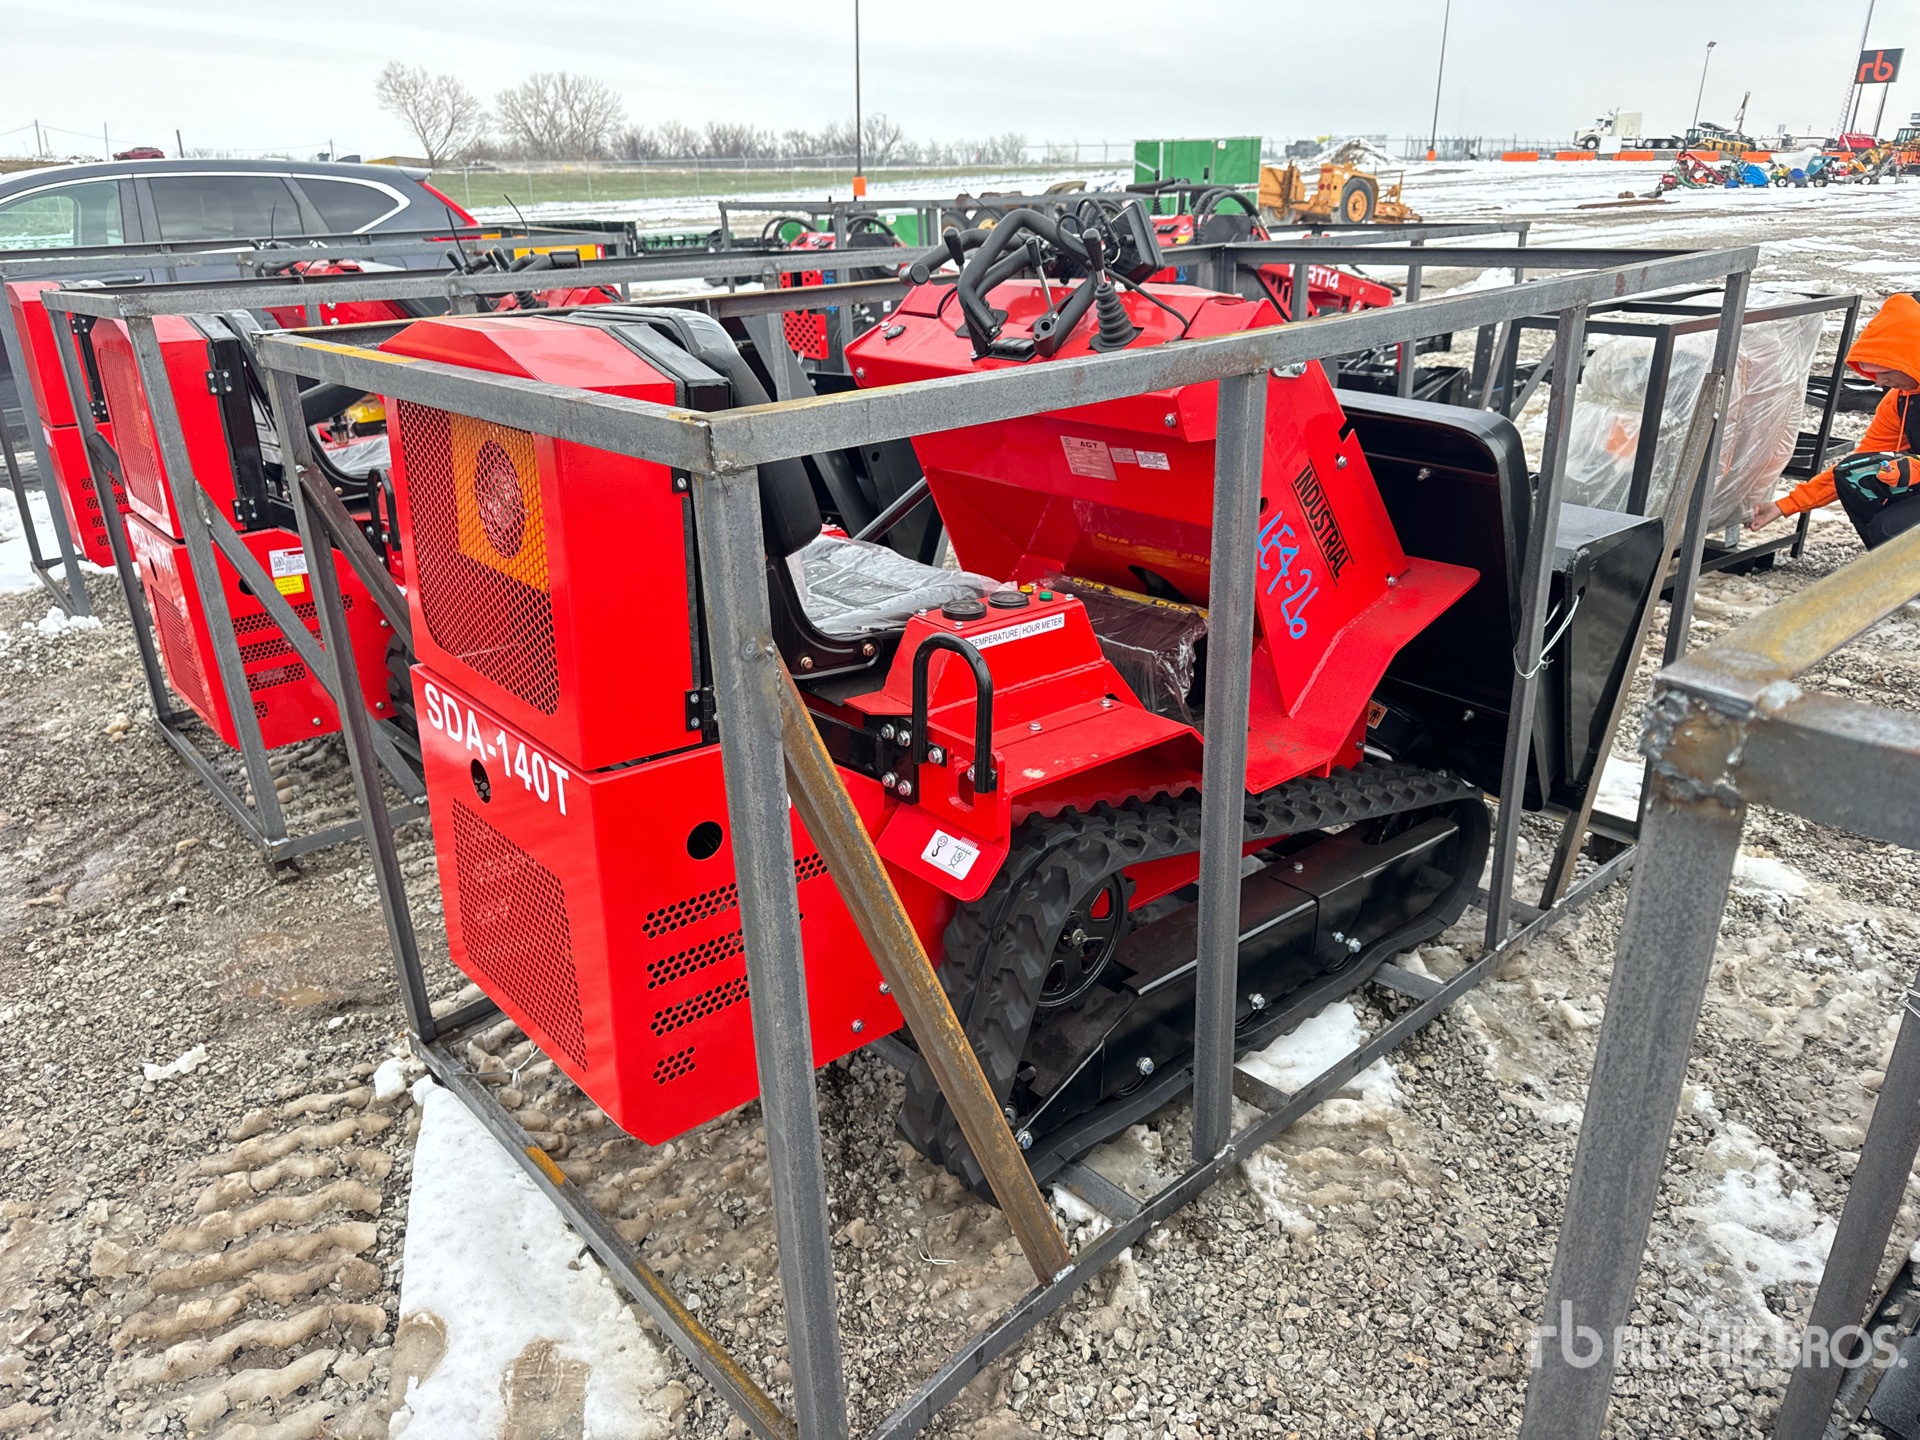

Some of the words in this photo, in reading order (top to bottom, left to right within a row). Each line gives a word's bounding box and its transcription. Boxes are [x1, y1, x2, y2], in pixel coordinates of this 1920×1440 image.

[1858, 51, 1894, 82] rb
[1080, 440, 1098, 449] AGT
[1293, 463, 1352, 580] INDUSTRIAL
[970, 627, 1019, 647] TEMPERATURE
[1022, 623, 1041, 635] HOUR
[1041, 616, 1063, 630] METER
[424, 682, 570, 817] SDA-140T
